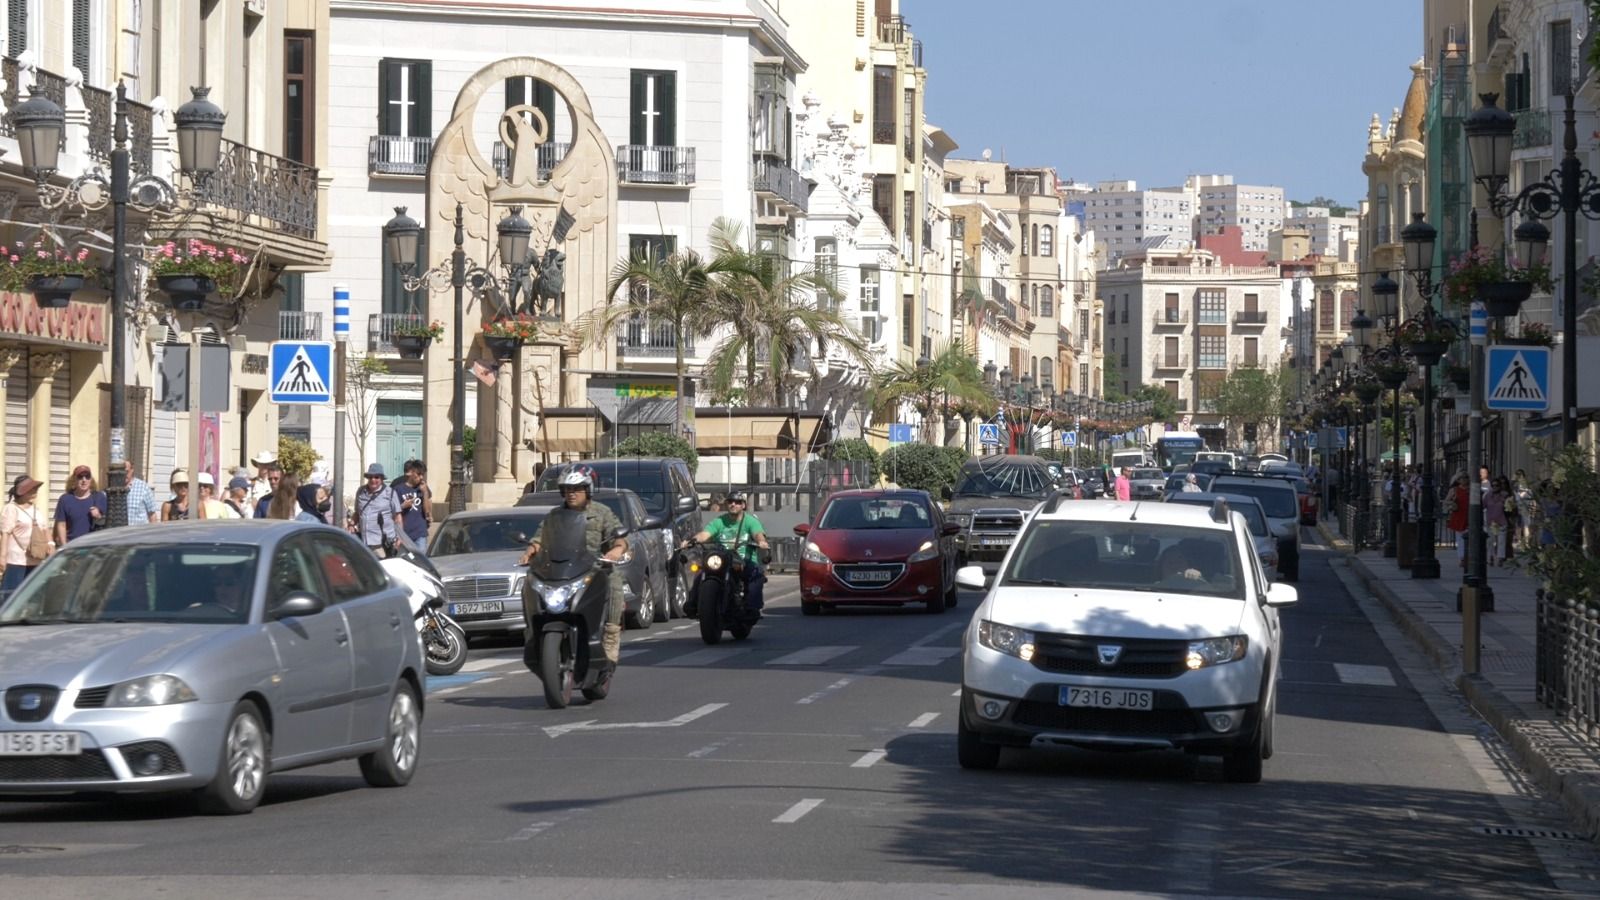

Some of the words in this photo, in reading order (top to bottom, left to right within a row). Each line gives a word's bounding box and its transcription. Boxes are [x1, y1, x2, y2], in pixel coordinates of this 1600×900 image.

[634, 384, 674, 396] ONCE
[456, 603, 479, 614] 3677
[481, 601, 500, 611] HPN
[1071, 688, 1112, 706] 7316
[1118, 691, 1150, 708] JDS
